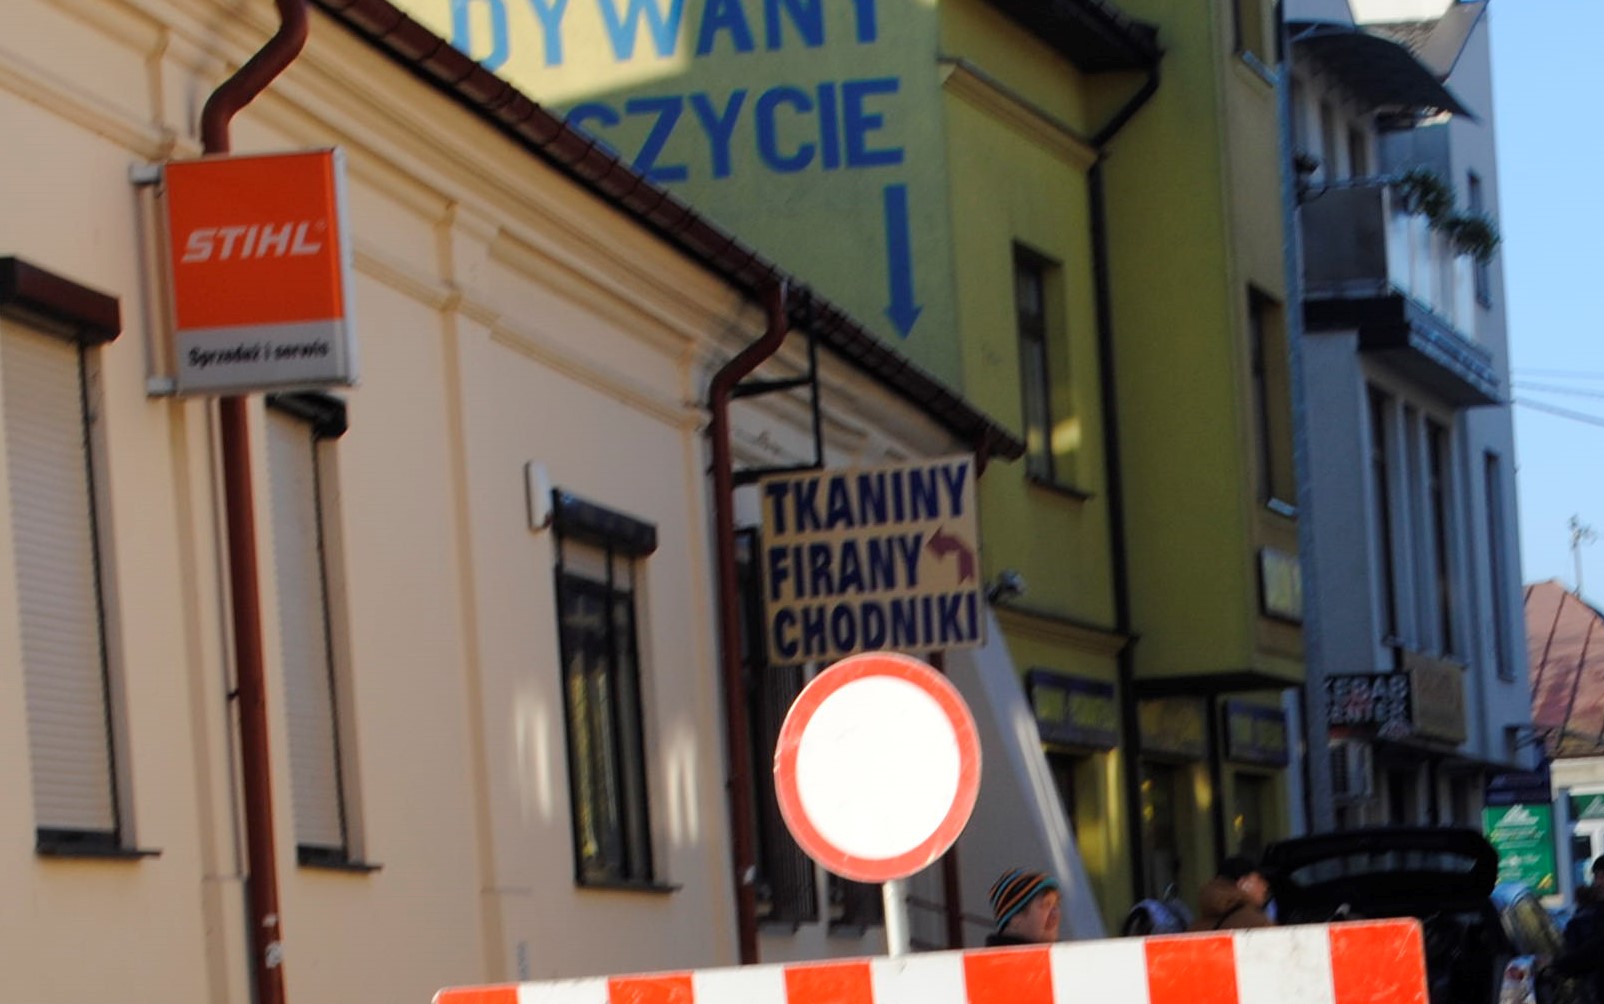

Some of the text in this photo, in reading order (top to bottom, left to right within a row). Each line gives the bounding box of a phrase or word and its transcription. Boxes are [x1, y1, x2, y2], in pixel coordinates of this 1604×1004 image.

[181, 221, 321, 263] STIHL
[765, 462, 967, 536] TKANINY
[768, 532, 924, 602] FIRANY
[772, 590, 979, 660] CHODNIKI
